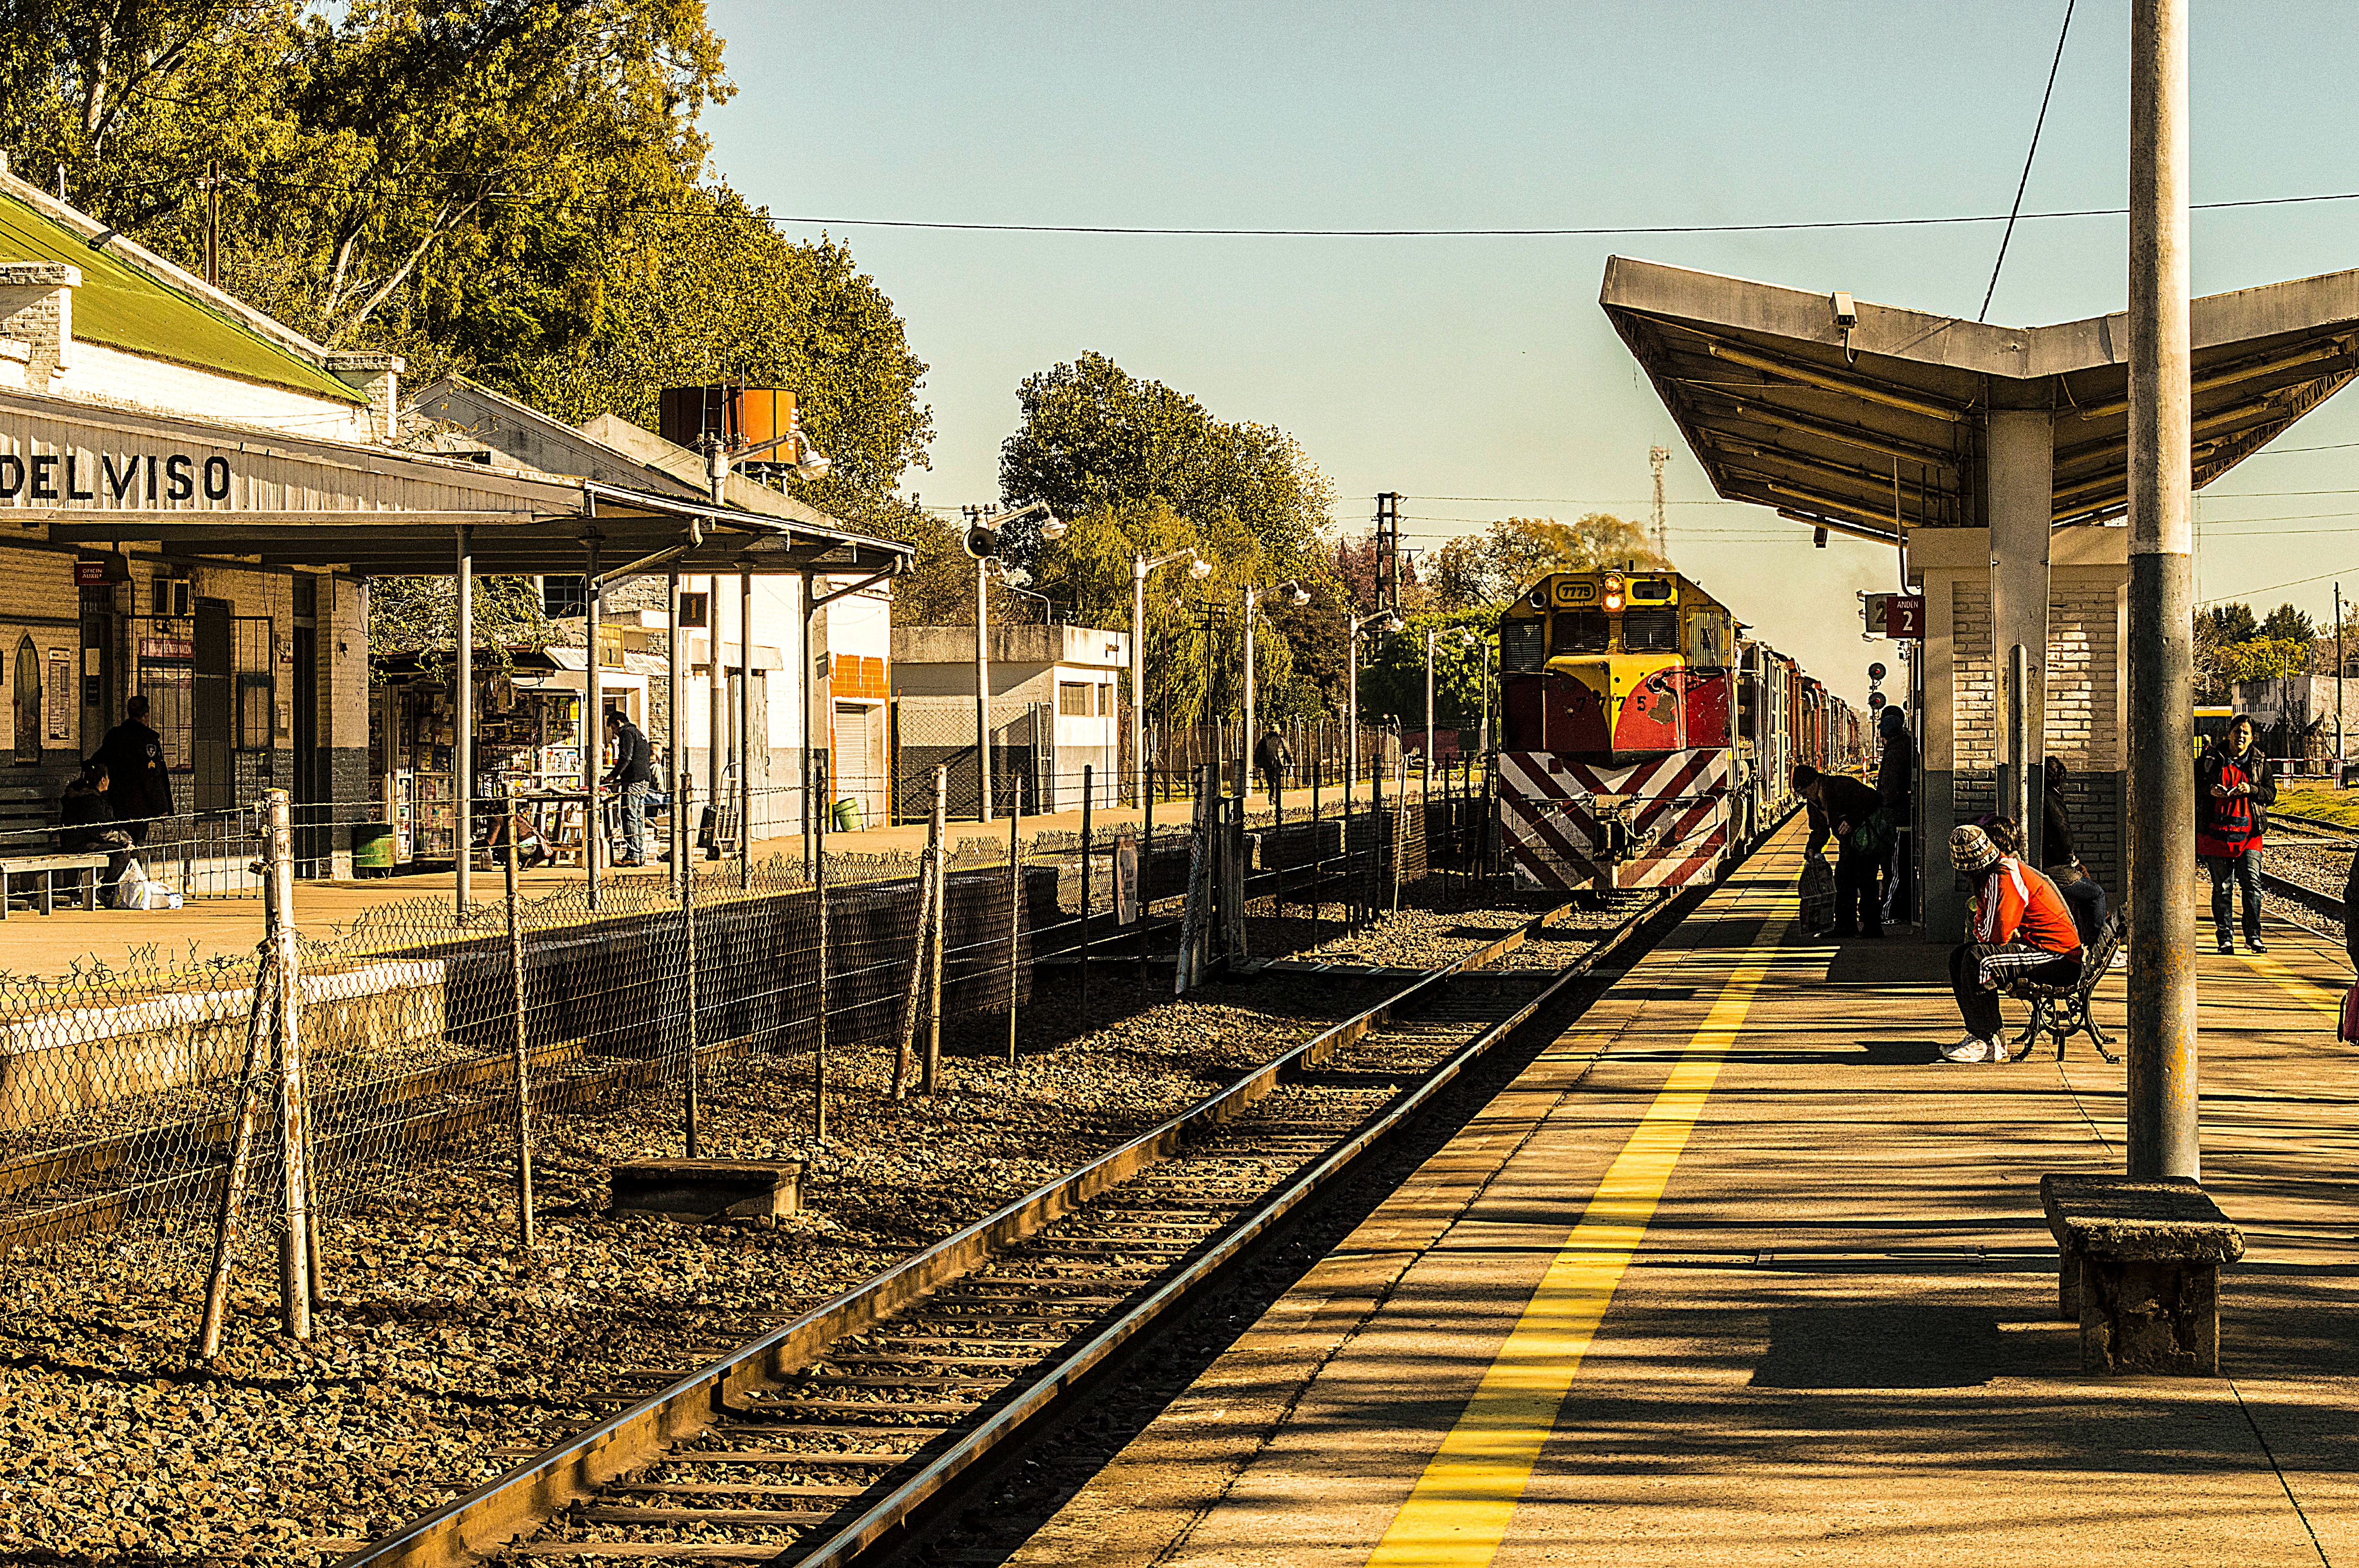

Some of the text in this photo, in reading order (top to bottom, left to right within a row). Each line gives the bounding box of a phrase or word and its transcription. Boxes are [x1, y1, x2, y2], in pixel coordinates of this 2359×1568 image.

[1563, 587, 1591, 597] 7775
[1897, 599, 1918, 609] ANDÉN
[1902, 611, 1913, 631] 2
